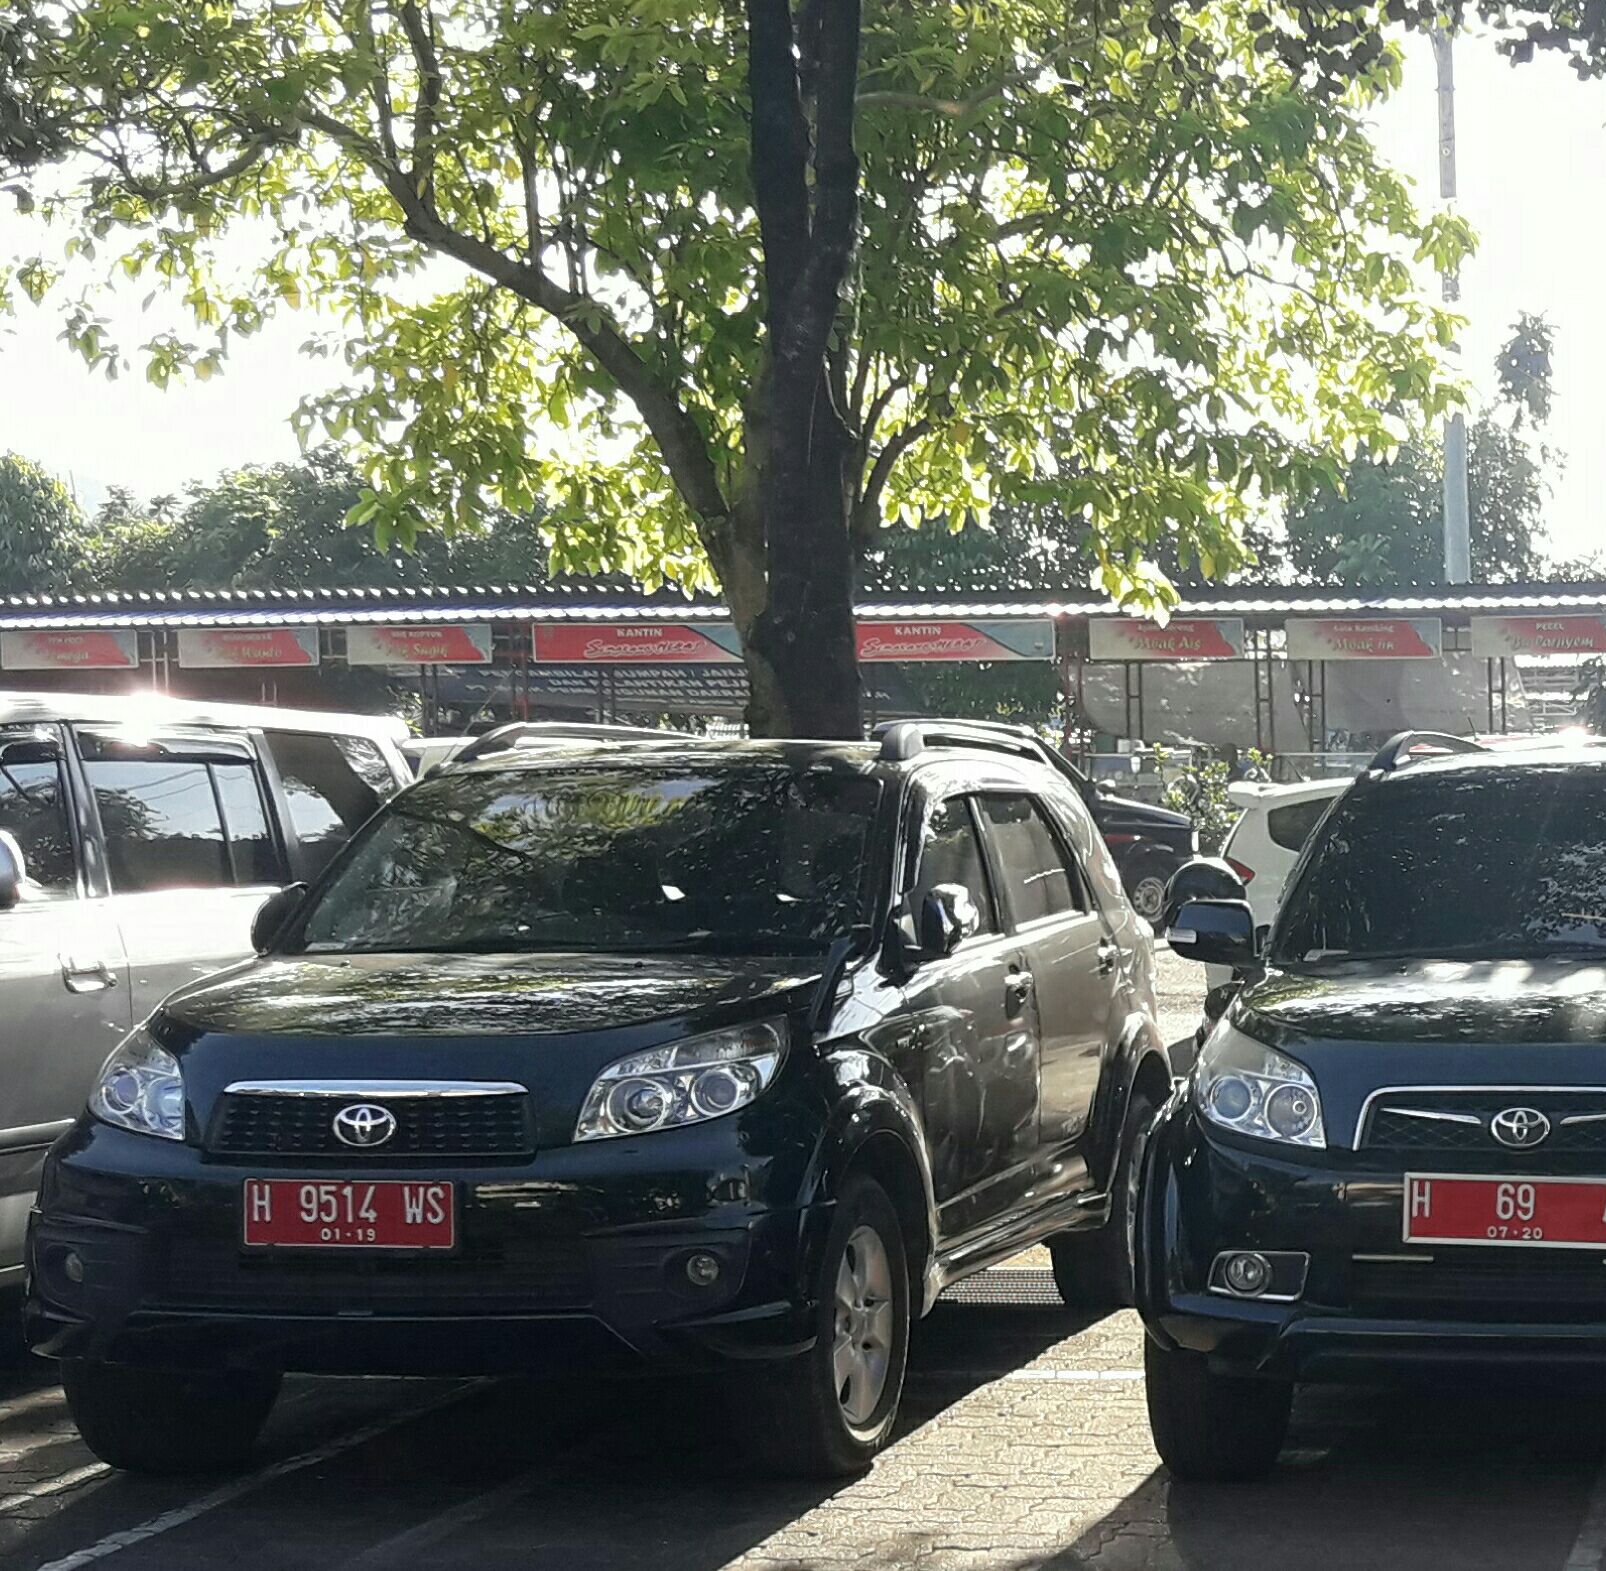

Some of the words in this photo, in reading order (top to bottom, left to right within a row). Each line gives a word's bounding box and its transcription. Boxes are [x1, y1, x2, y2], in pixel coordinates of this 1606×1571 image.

[615, 628, 663, 637] KANTIN
[894, 625, 941, 635] KANTIN
[252, 1184, 271, 1222] H
[300, 1184, 378, 1223] 9514
[403, 1186, 446, 1224] WS
[1412, 1180, 1431, 1218] H
[1496, 1183, 1536, 1221] 69
